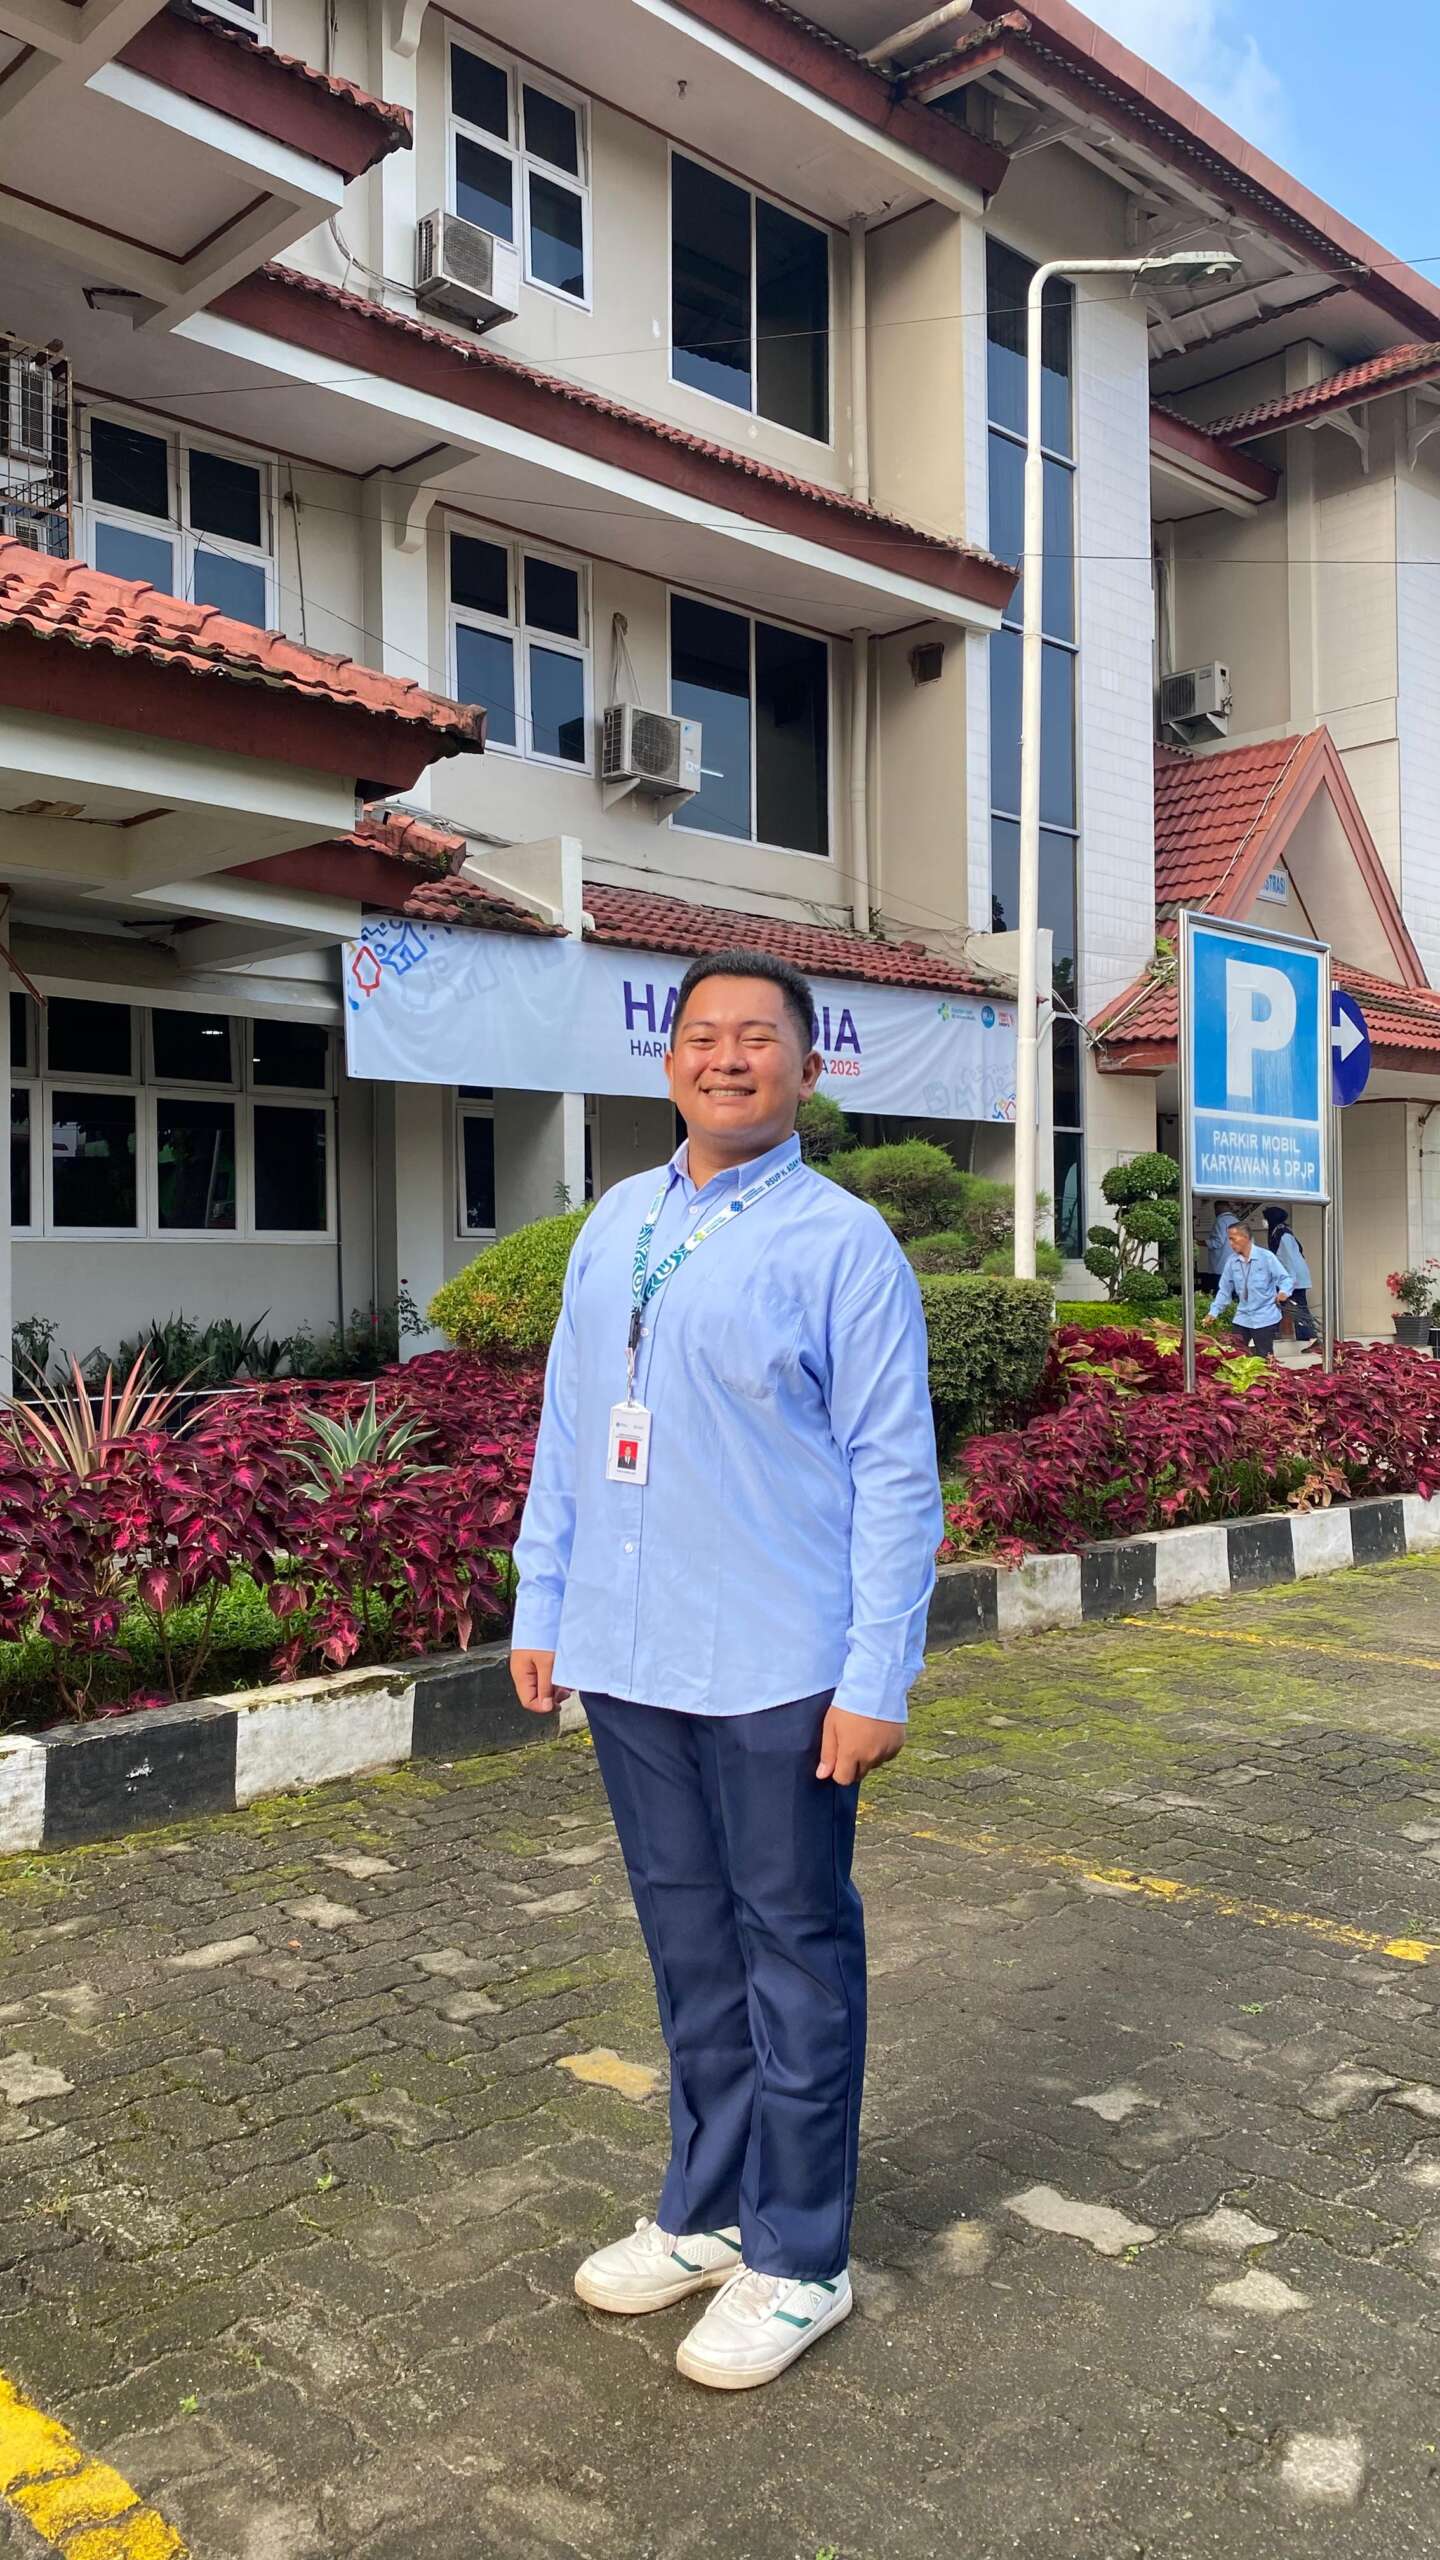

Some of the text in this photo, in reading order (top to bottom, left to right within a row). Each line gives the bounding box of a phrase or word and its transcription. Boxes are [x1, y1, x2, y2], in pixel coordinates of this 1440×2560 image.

[1226, 959, 1297, 1098] P
[830, 1059, 861, 1076] 2025
[1213, 1130, 1301, 1153] PARKIR MOBIL
[1201, 1153, 1315, 1180] KARYAWAN & DPJP
